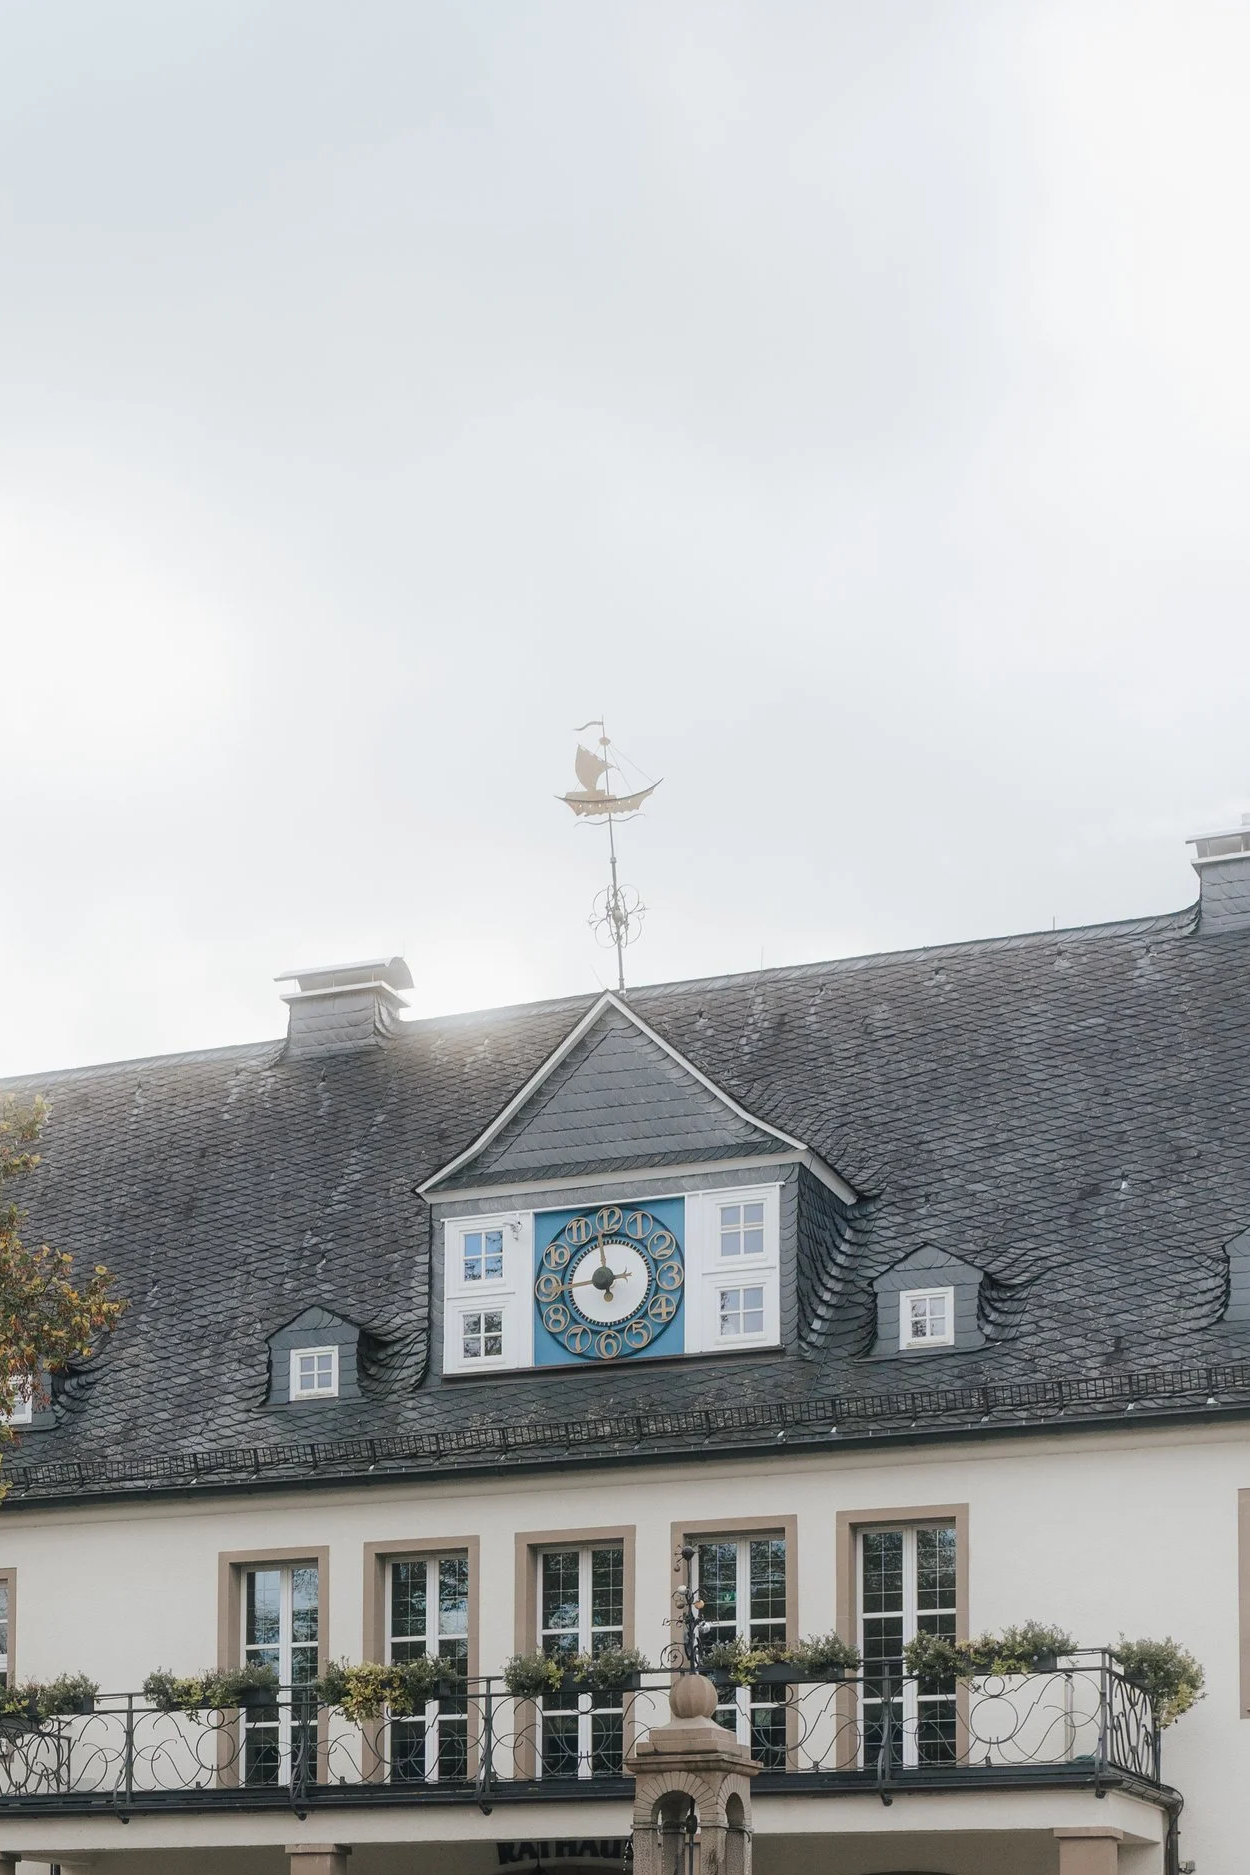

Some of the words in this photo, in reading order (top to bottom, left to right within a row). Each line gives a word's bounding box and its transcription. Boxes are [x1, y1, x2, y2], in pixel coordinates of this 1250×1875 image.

[568, 1219, 587, 1244] 11
[600, 1207, 620, 1232] 12
[629, 1212, 644, 1239] 1
[547, 1246, 569, 1268] 10
[652, 1233, 672, 1258] 2
[539, 1275, 558, 1301] 9
[662, 1263, 681, 1289] 3
[549, 1305, 565, 1331] 8
[650, 1296, 675, 1321] 4
[568, 1327, 588, 1352] 7
[599, 1331, 618, 1358] 6
[631, 1322, 648, 1348] 5
